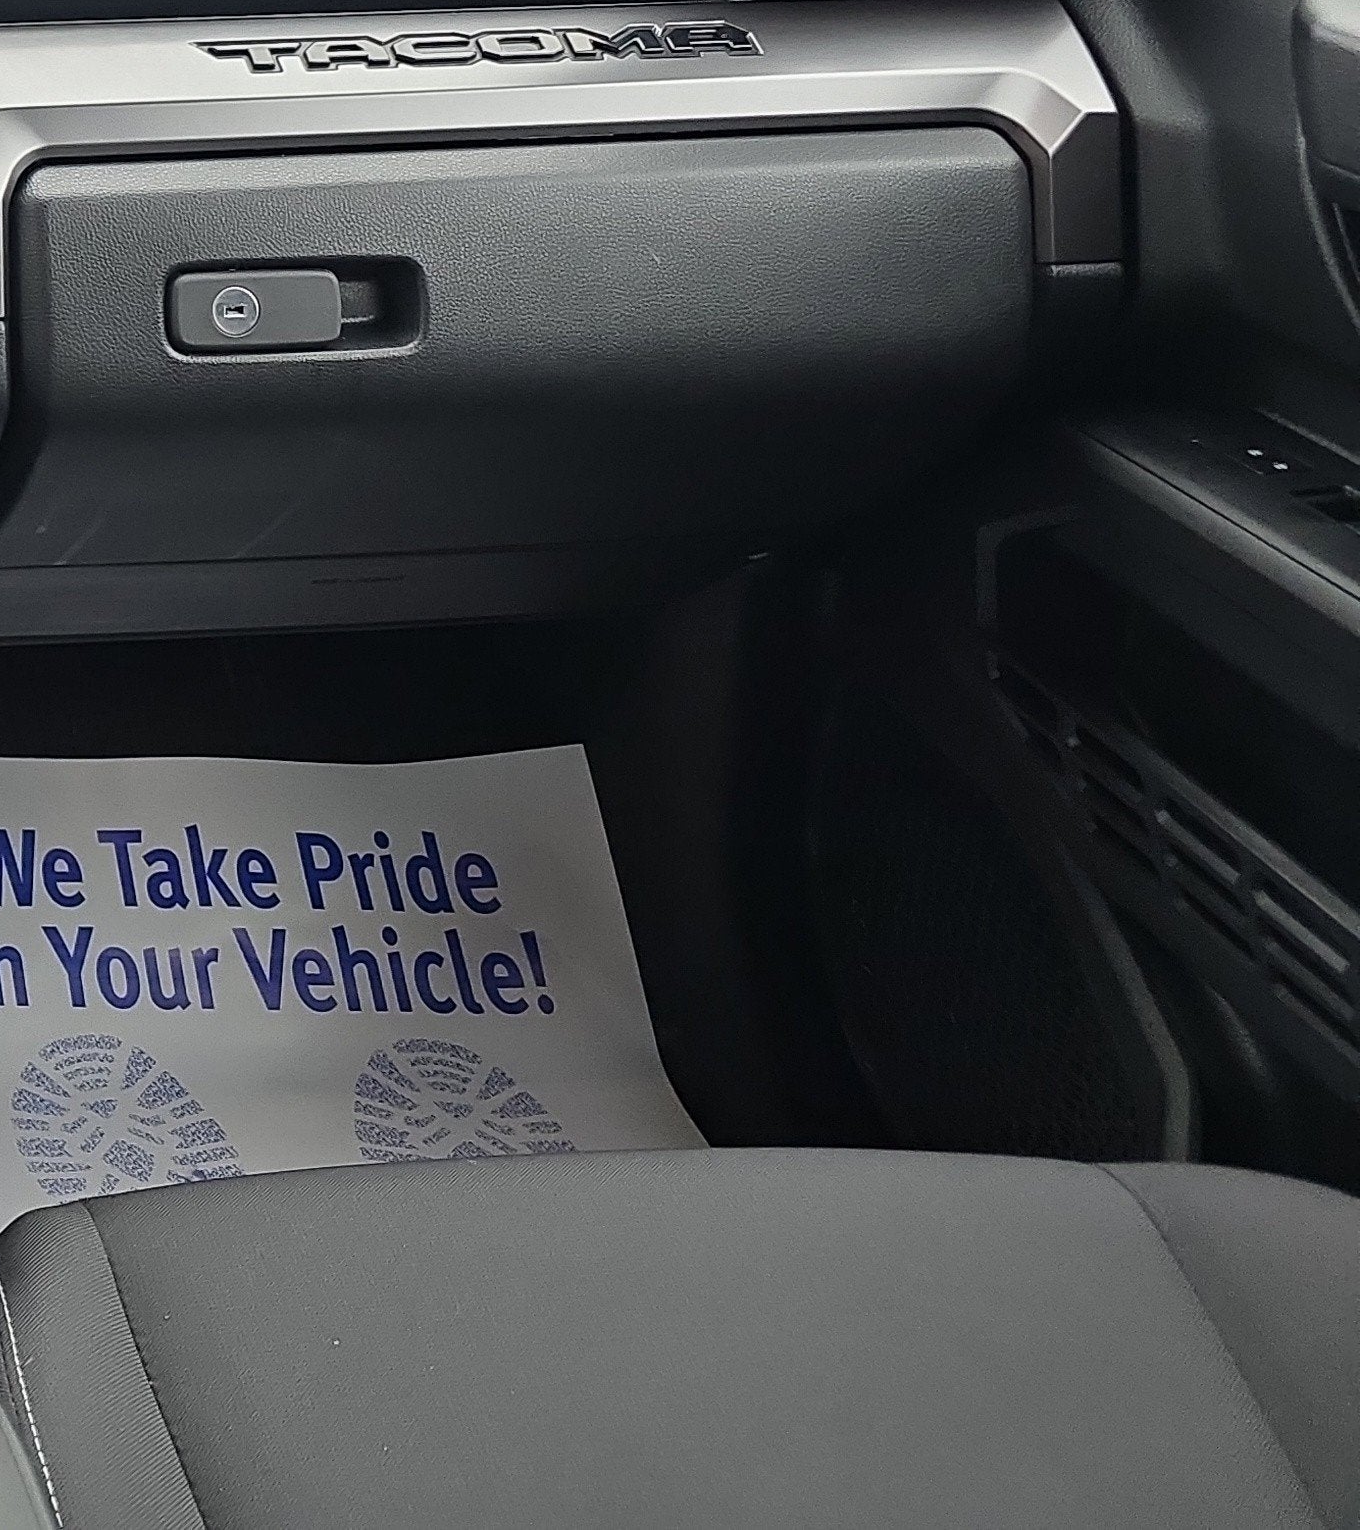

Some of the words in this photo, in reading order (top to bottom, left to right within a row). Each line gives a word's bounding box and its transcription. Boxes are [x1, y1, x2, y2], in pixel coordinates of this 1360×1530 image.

[187, 19, 767, 74] TACOMA
[96, 824, 281, 911] Take
[295, 830, 499, 914] Pride
[41, 925, 220, 1011] Your
[232, 925, 556, 1015] Vehicle!
